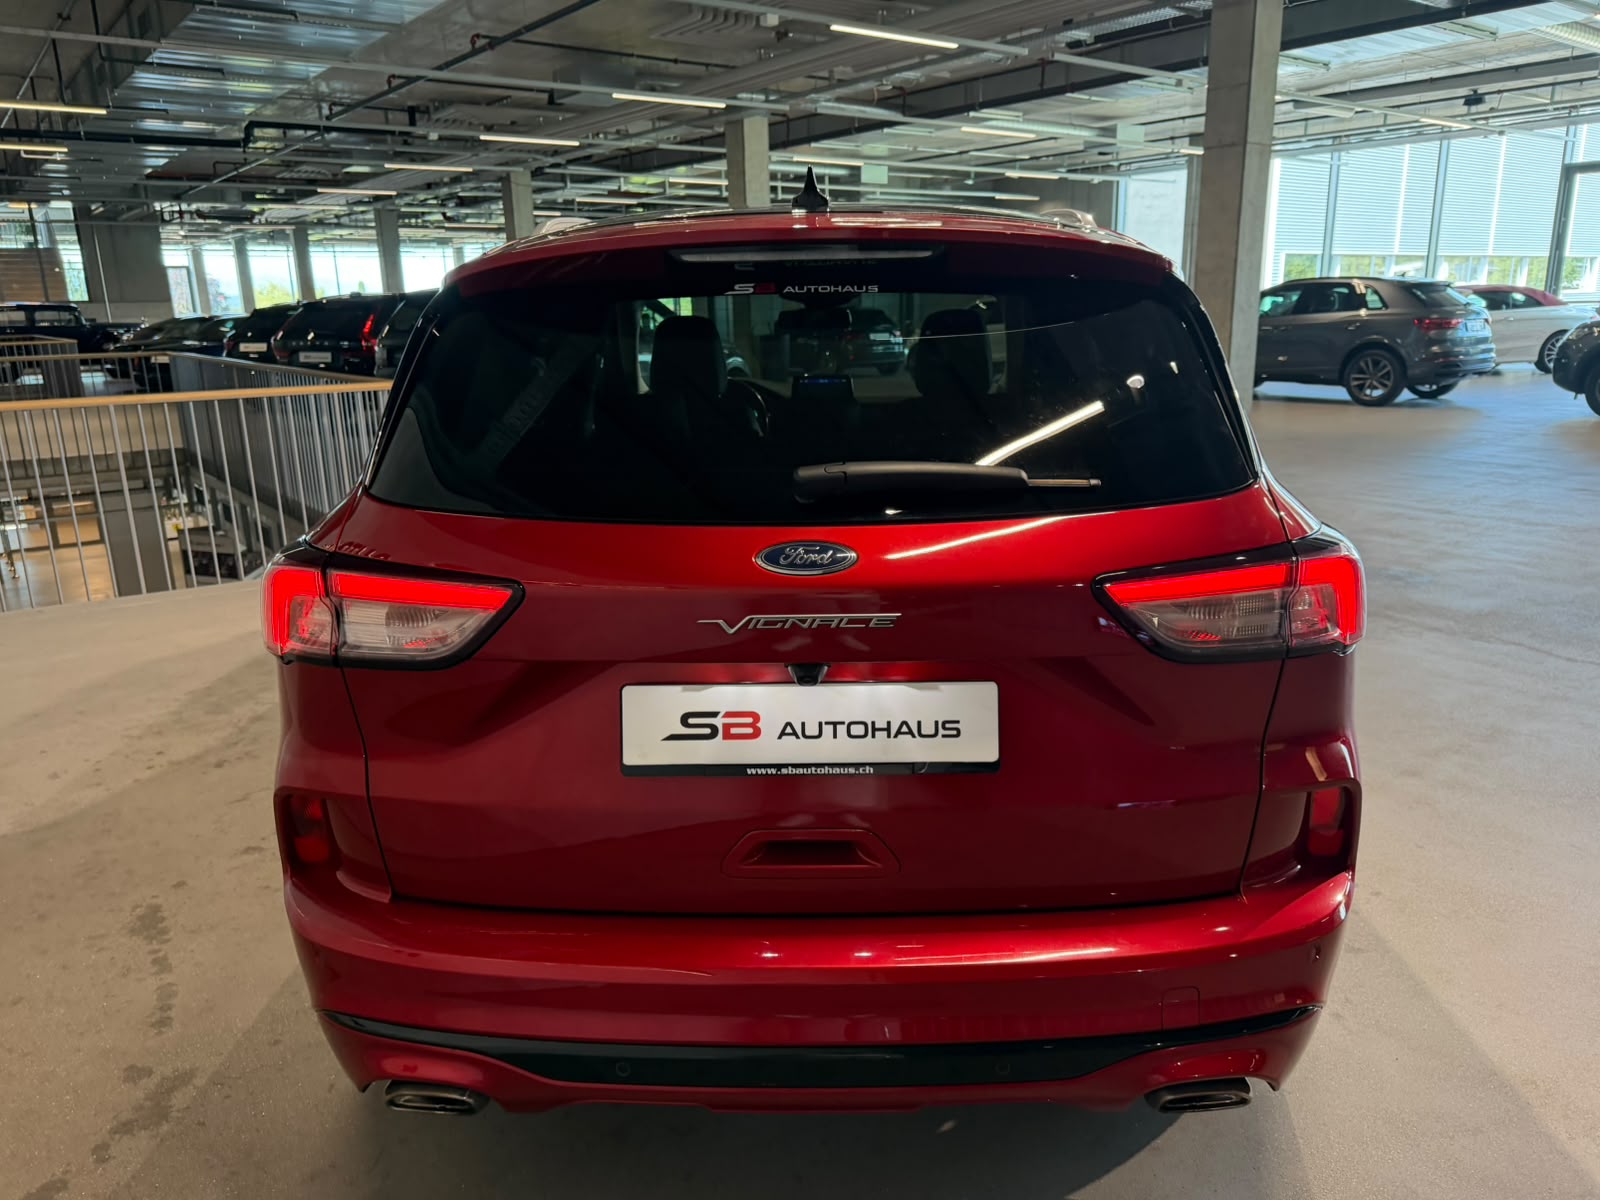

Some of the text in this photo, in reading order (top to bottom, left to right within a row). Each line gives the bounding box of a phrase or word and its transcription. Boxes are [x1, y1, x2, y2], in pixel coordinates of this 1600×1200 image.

[783, 285, 879, 293] AUTOHAUS
[779, 546, 832, 565] Ford
[697, 613, 902, 634] VIGNALE
[660, 711, 962, 741] SB AUTOHAUS
[746, 766, 874, 776] www.sbautohaus.ch
